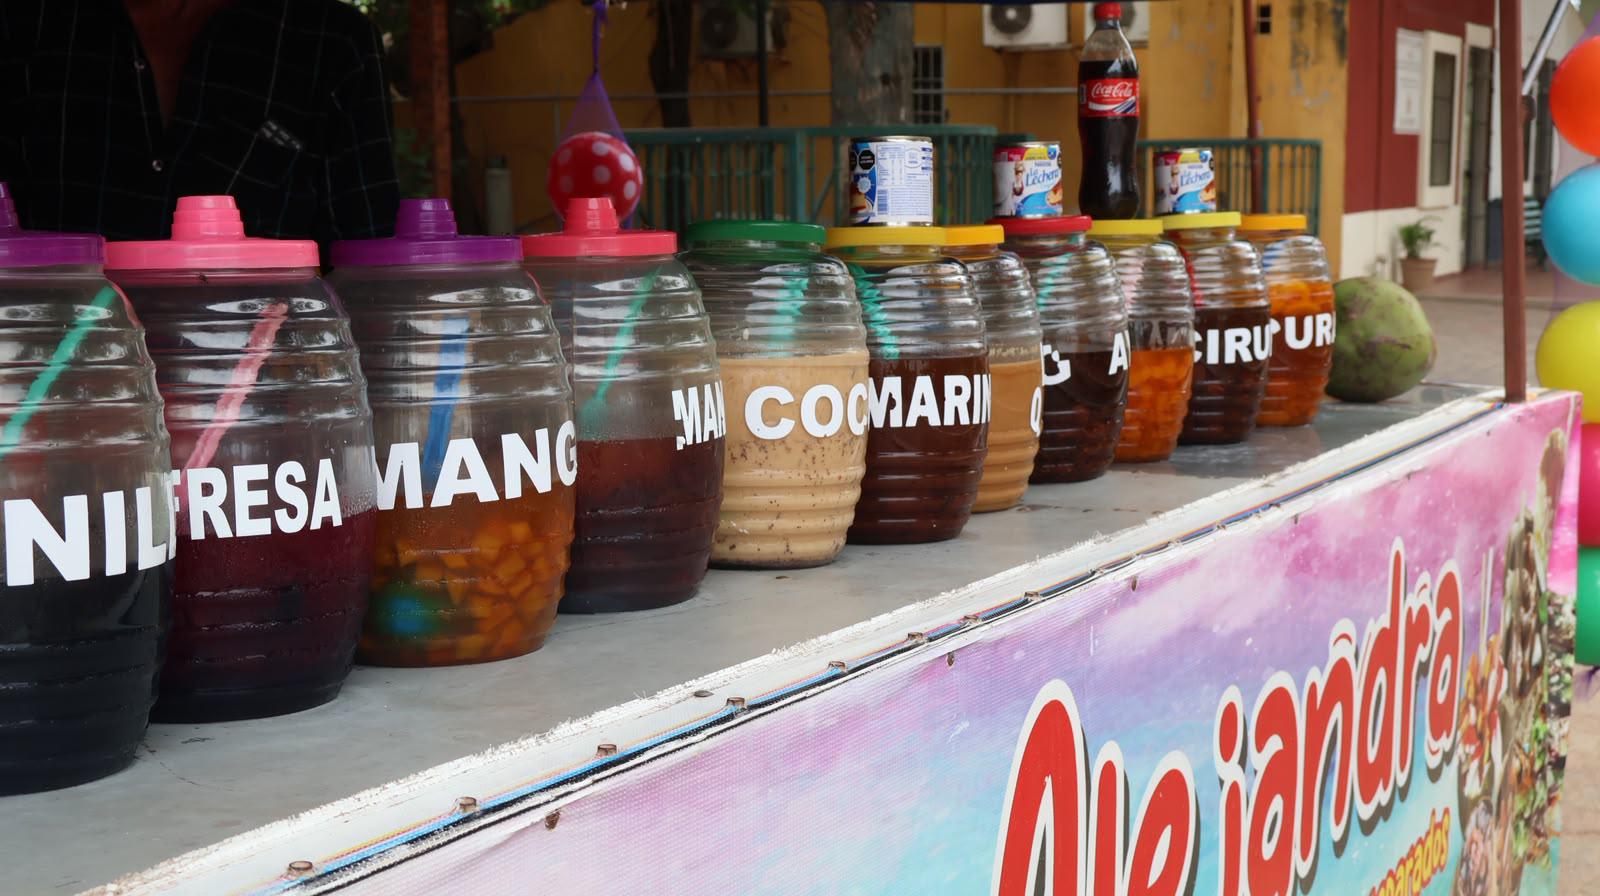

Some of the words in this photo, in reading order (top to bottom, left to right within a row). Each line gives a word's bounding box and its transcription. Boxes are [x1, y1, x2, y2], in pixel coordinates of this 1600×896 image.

[1108, 330, 1131, 375] A
[1270, 310, 1336, 350] UR
[373, 420, 577, 510] MANG
[4, 482, 176, 587] NIL
